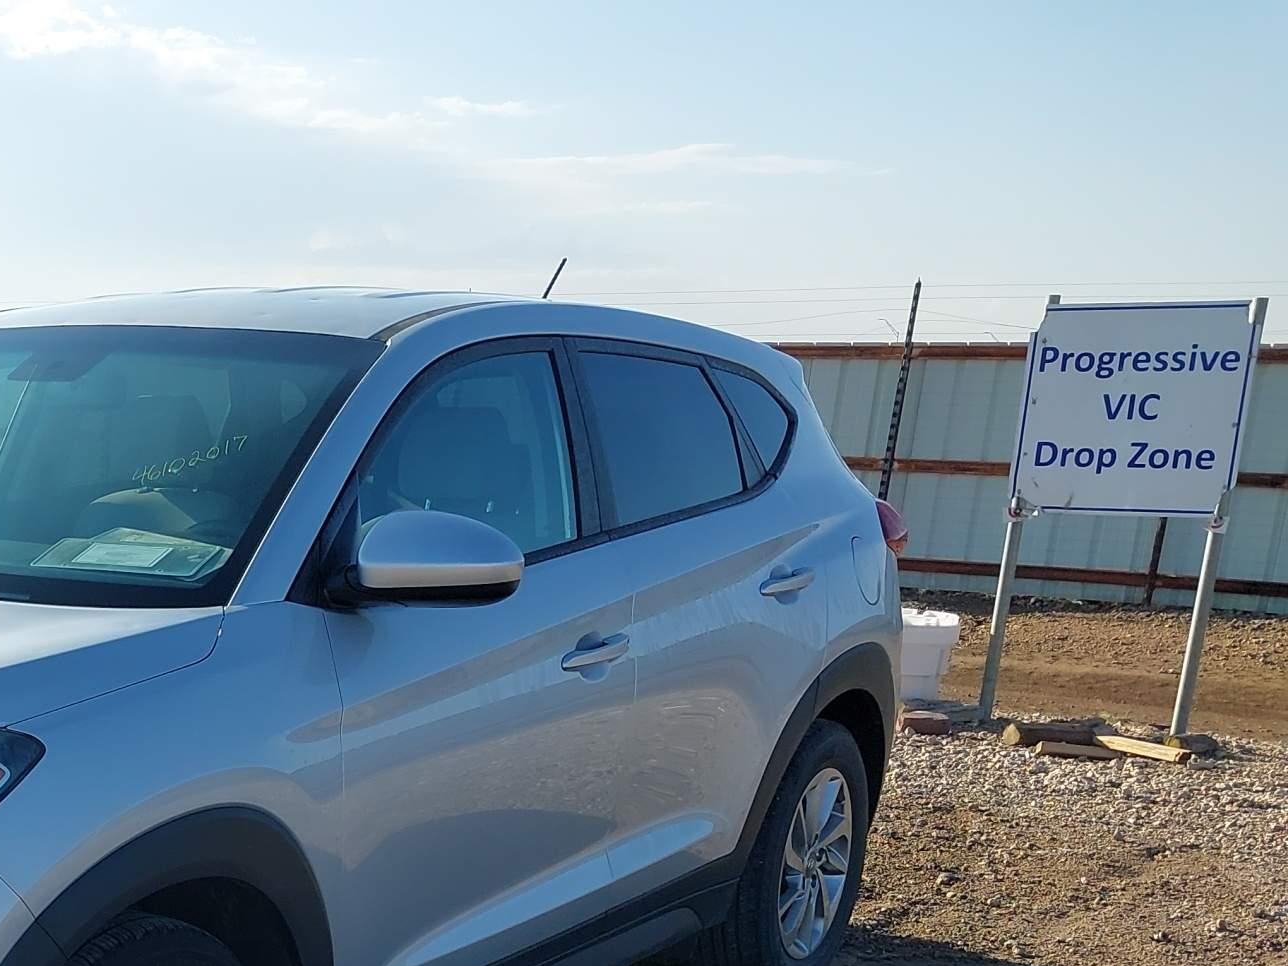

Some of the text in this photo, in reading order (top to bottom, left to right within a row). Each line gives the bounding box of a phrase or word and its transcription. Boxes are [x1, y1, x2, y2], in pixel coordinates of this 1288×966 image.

[1039, 343, 1241, 379] Progressive
[1103, 393, 1161, 421] VIC
[132, 434, 249, 486] 46102017
[1033, 441, 1216, 474] Drop Zone
